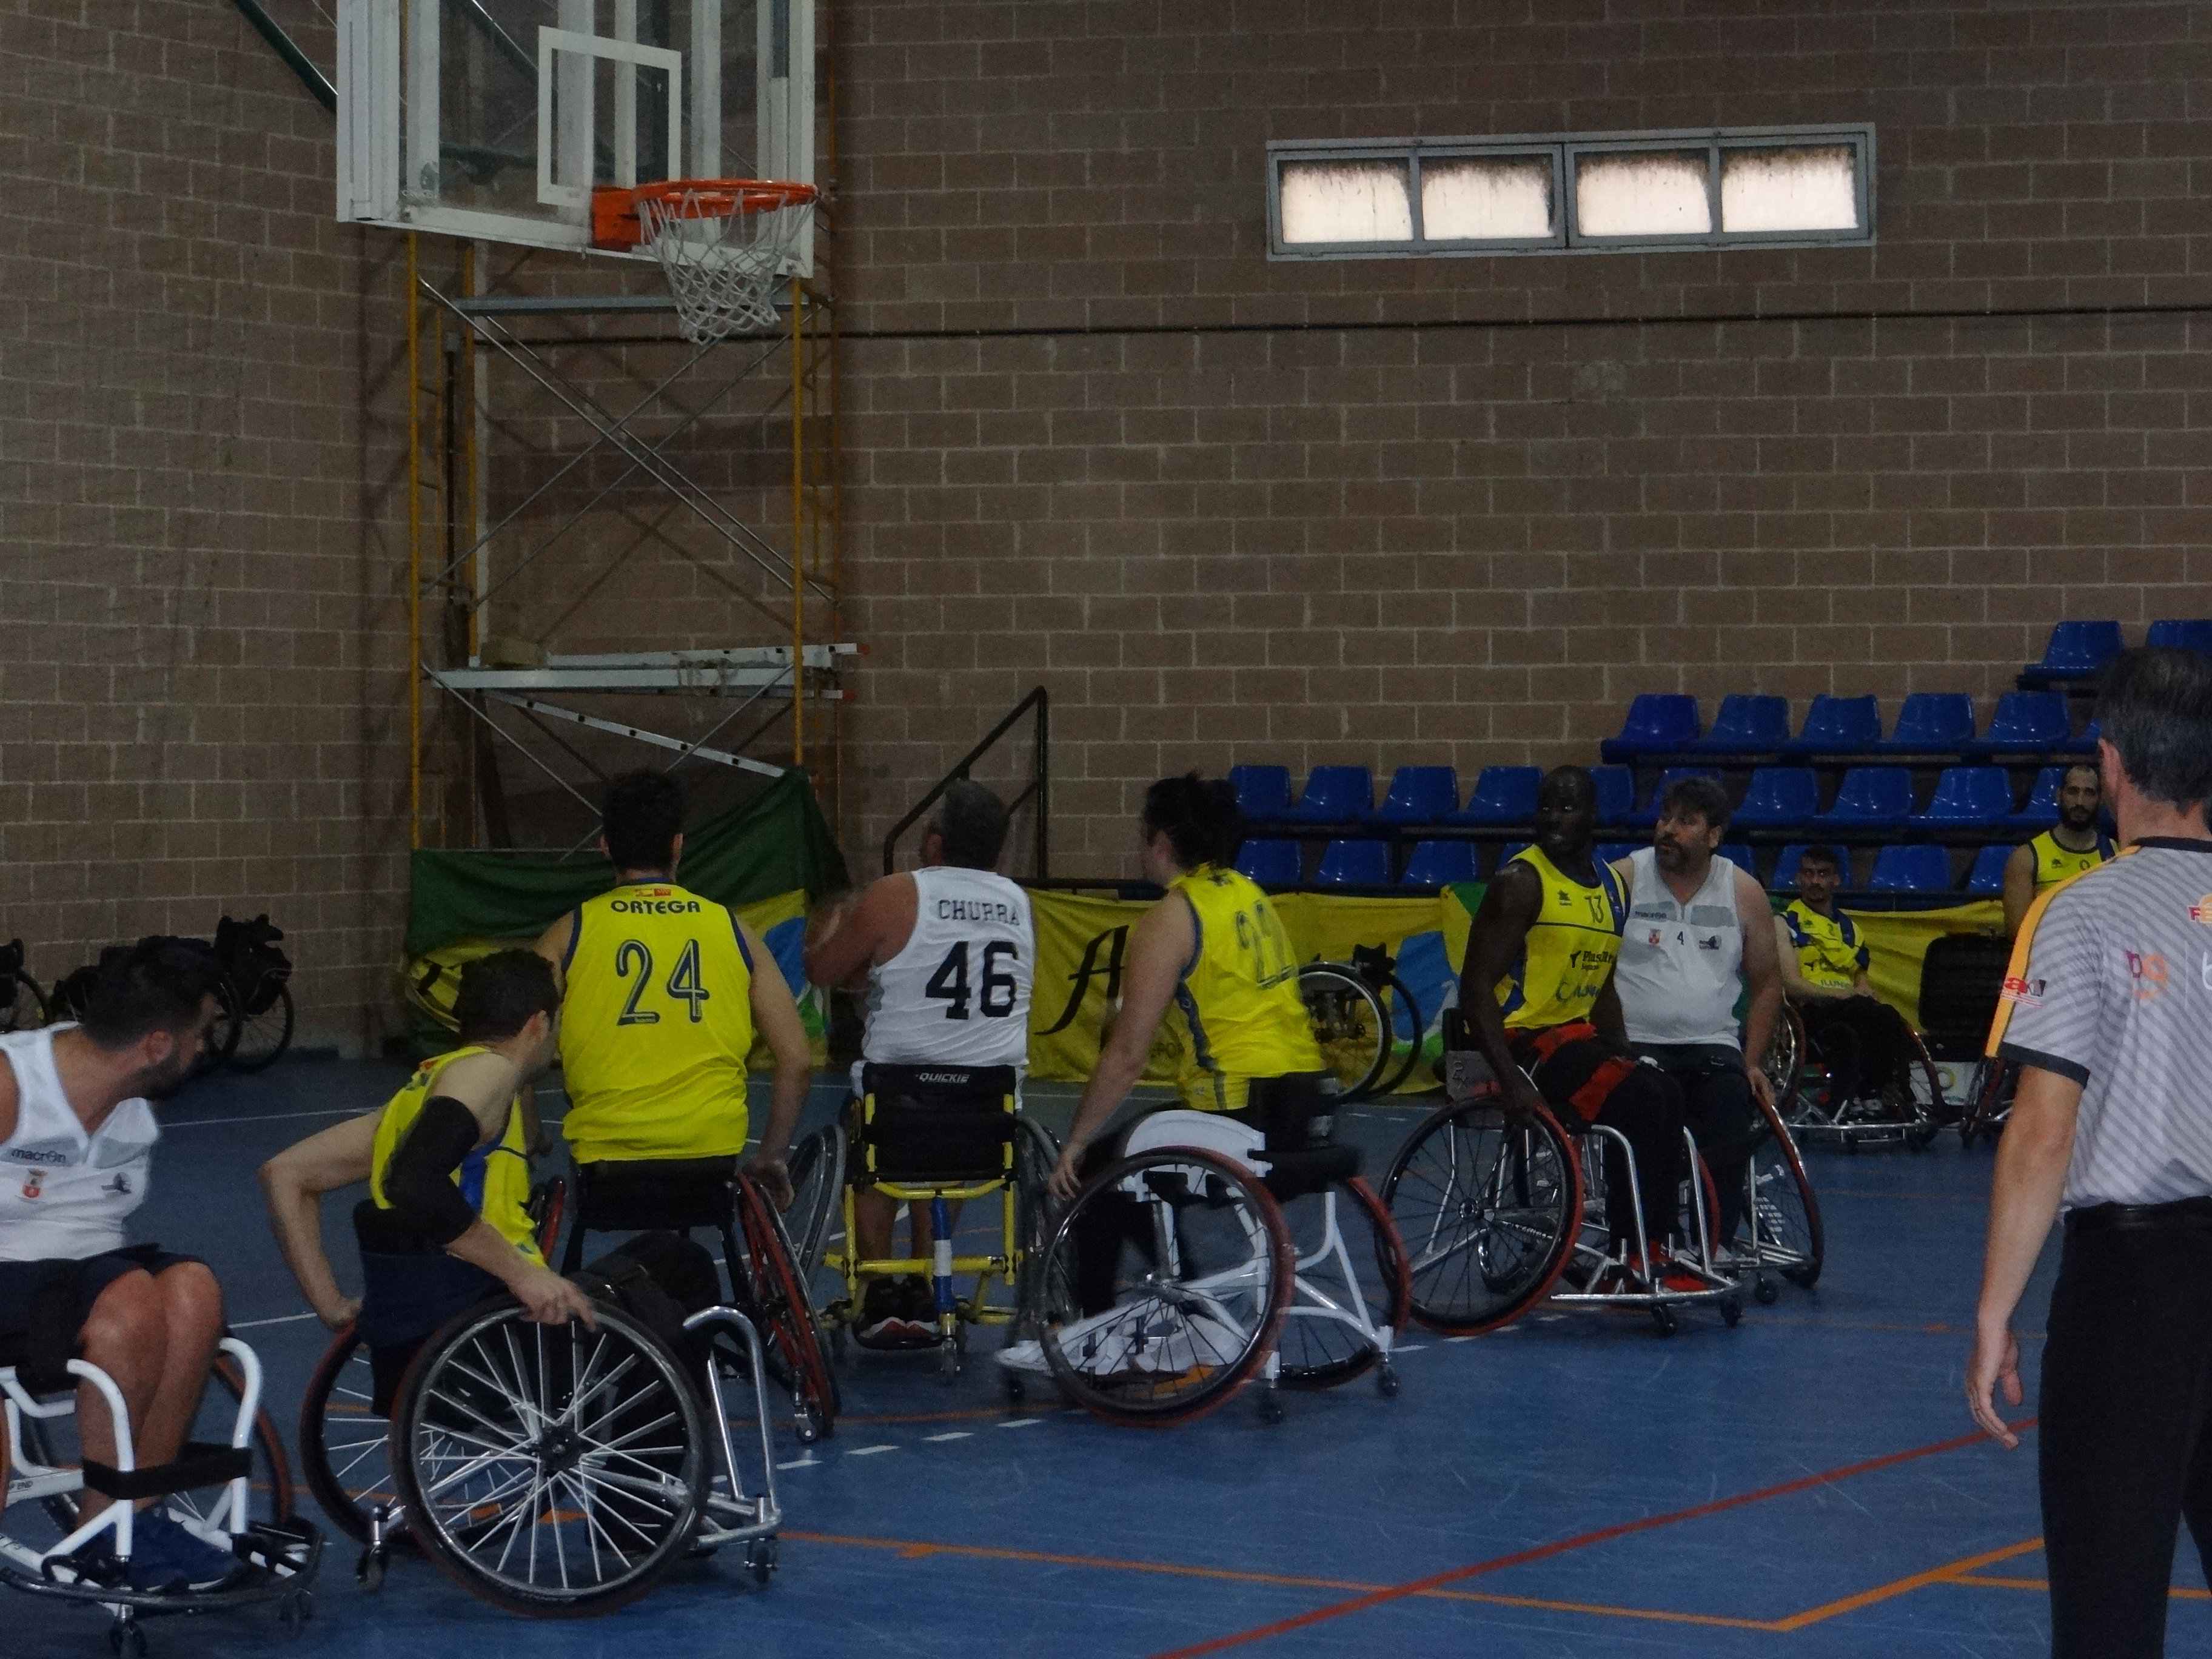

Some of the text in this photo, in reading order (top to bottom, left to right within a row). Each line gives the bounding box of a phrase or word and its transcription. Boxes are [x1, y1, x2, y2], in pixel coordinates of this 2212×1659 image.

[611, 899, 701, 914] ORTEGA
[938, 899, 1021, 926] CHURRA
[1677, 930, 1684, 946] 4
[615, 938, 710, 1026] 24
[925, 940, 1019, 1020] 46
[918, 1072, 971, 1084] QUICKIE
[11, 1148, 67, 1164] macron
